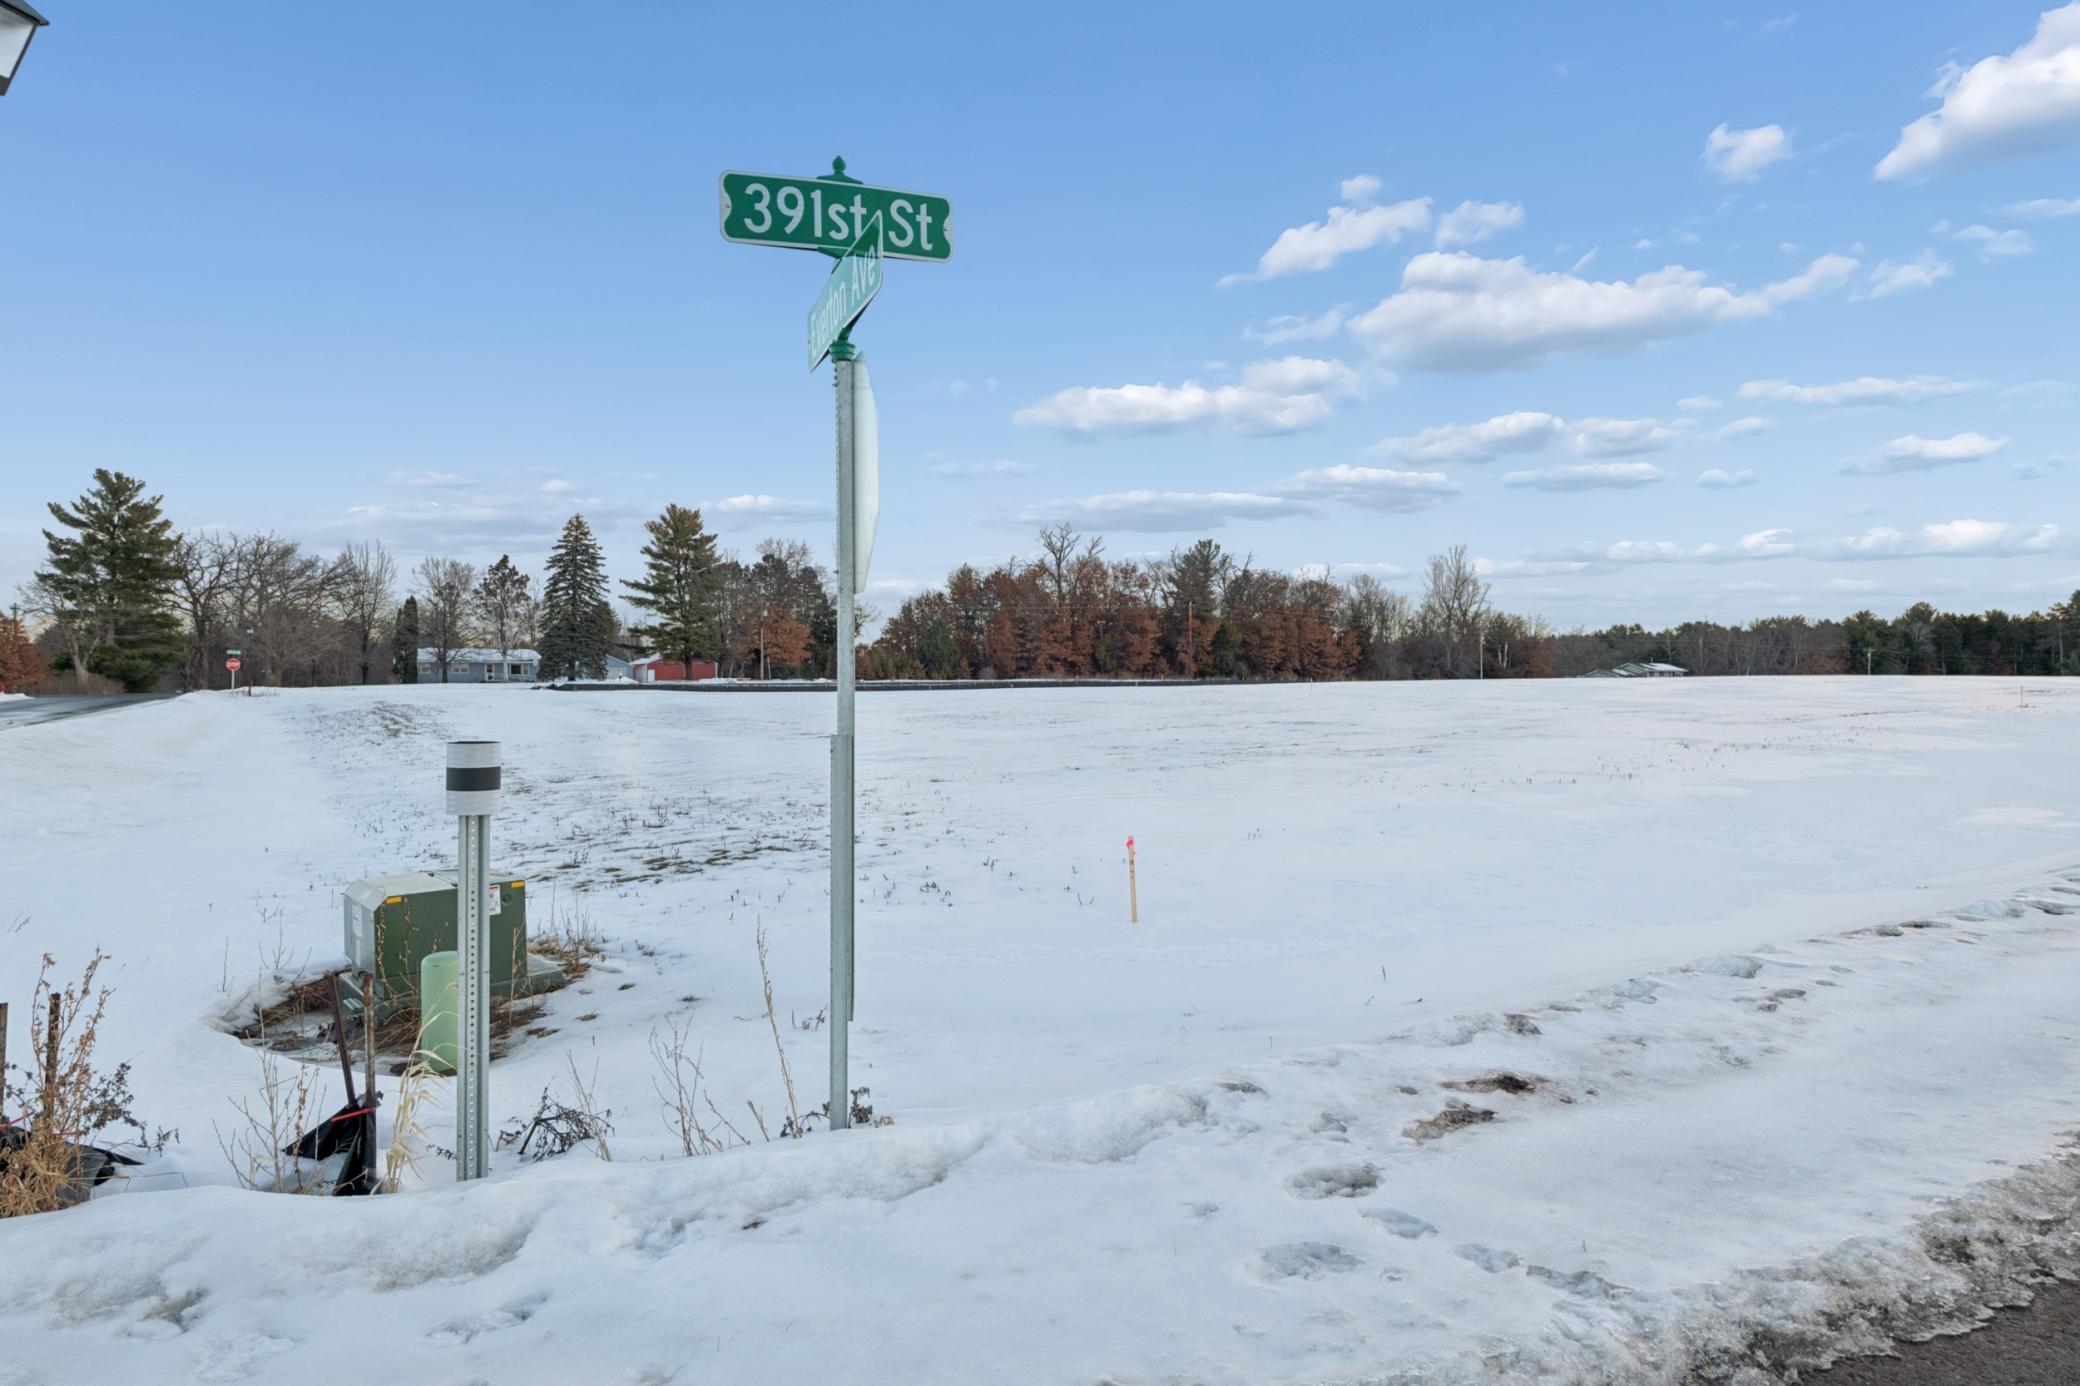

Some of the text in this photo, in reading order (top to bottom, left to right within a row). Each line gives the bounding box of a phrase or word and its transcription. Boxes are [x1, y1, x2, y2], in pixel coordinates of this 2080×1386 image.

[744, 183, 933, 251] 391st St
[811, 244, 876, 357] Everton Ave
